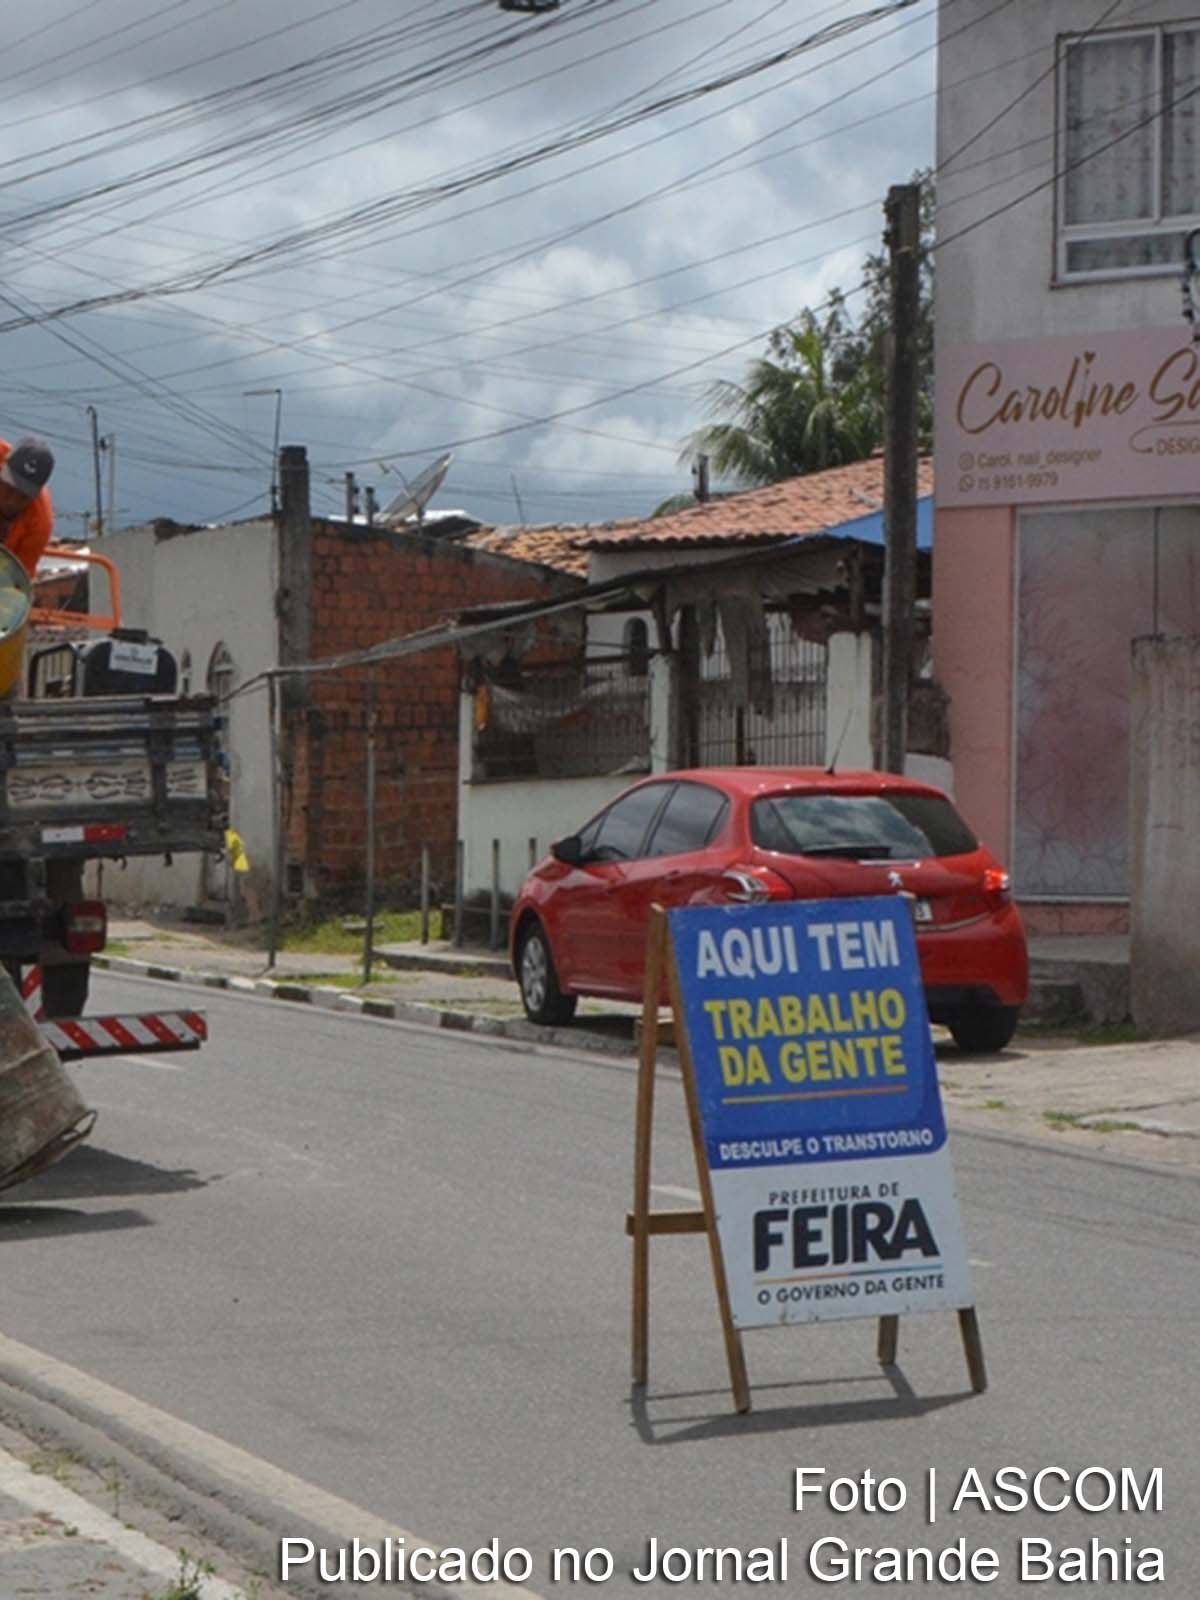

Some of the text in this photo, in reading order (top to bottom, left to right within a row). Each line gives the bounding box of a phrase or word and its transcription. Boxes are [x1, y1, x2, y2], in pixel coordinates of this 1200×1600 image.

[957, 351, 1139, 434] Caroline
[697, 919, 900, 979] AQUI TEM
[704, 988, 907, 1040] TRABALHO
[718, 1034, 907, 1087] DA GENTE
[719, 1127, 934, 1161] DESCULPE O TRANSTORNO
[768, 1181, 900, 1206] PREFEITURA DE
[753, 1197, 941, 1273] FEIRA
[757, 1273, 945, 1304] O GOVERNO DA GENTE
